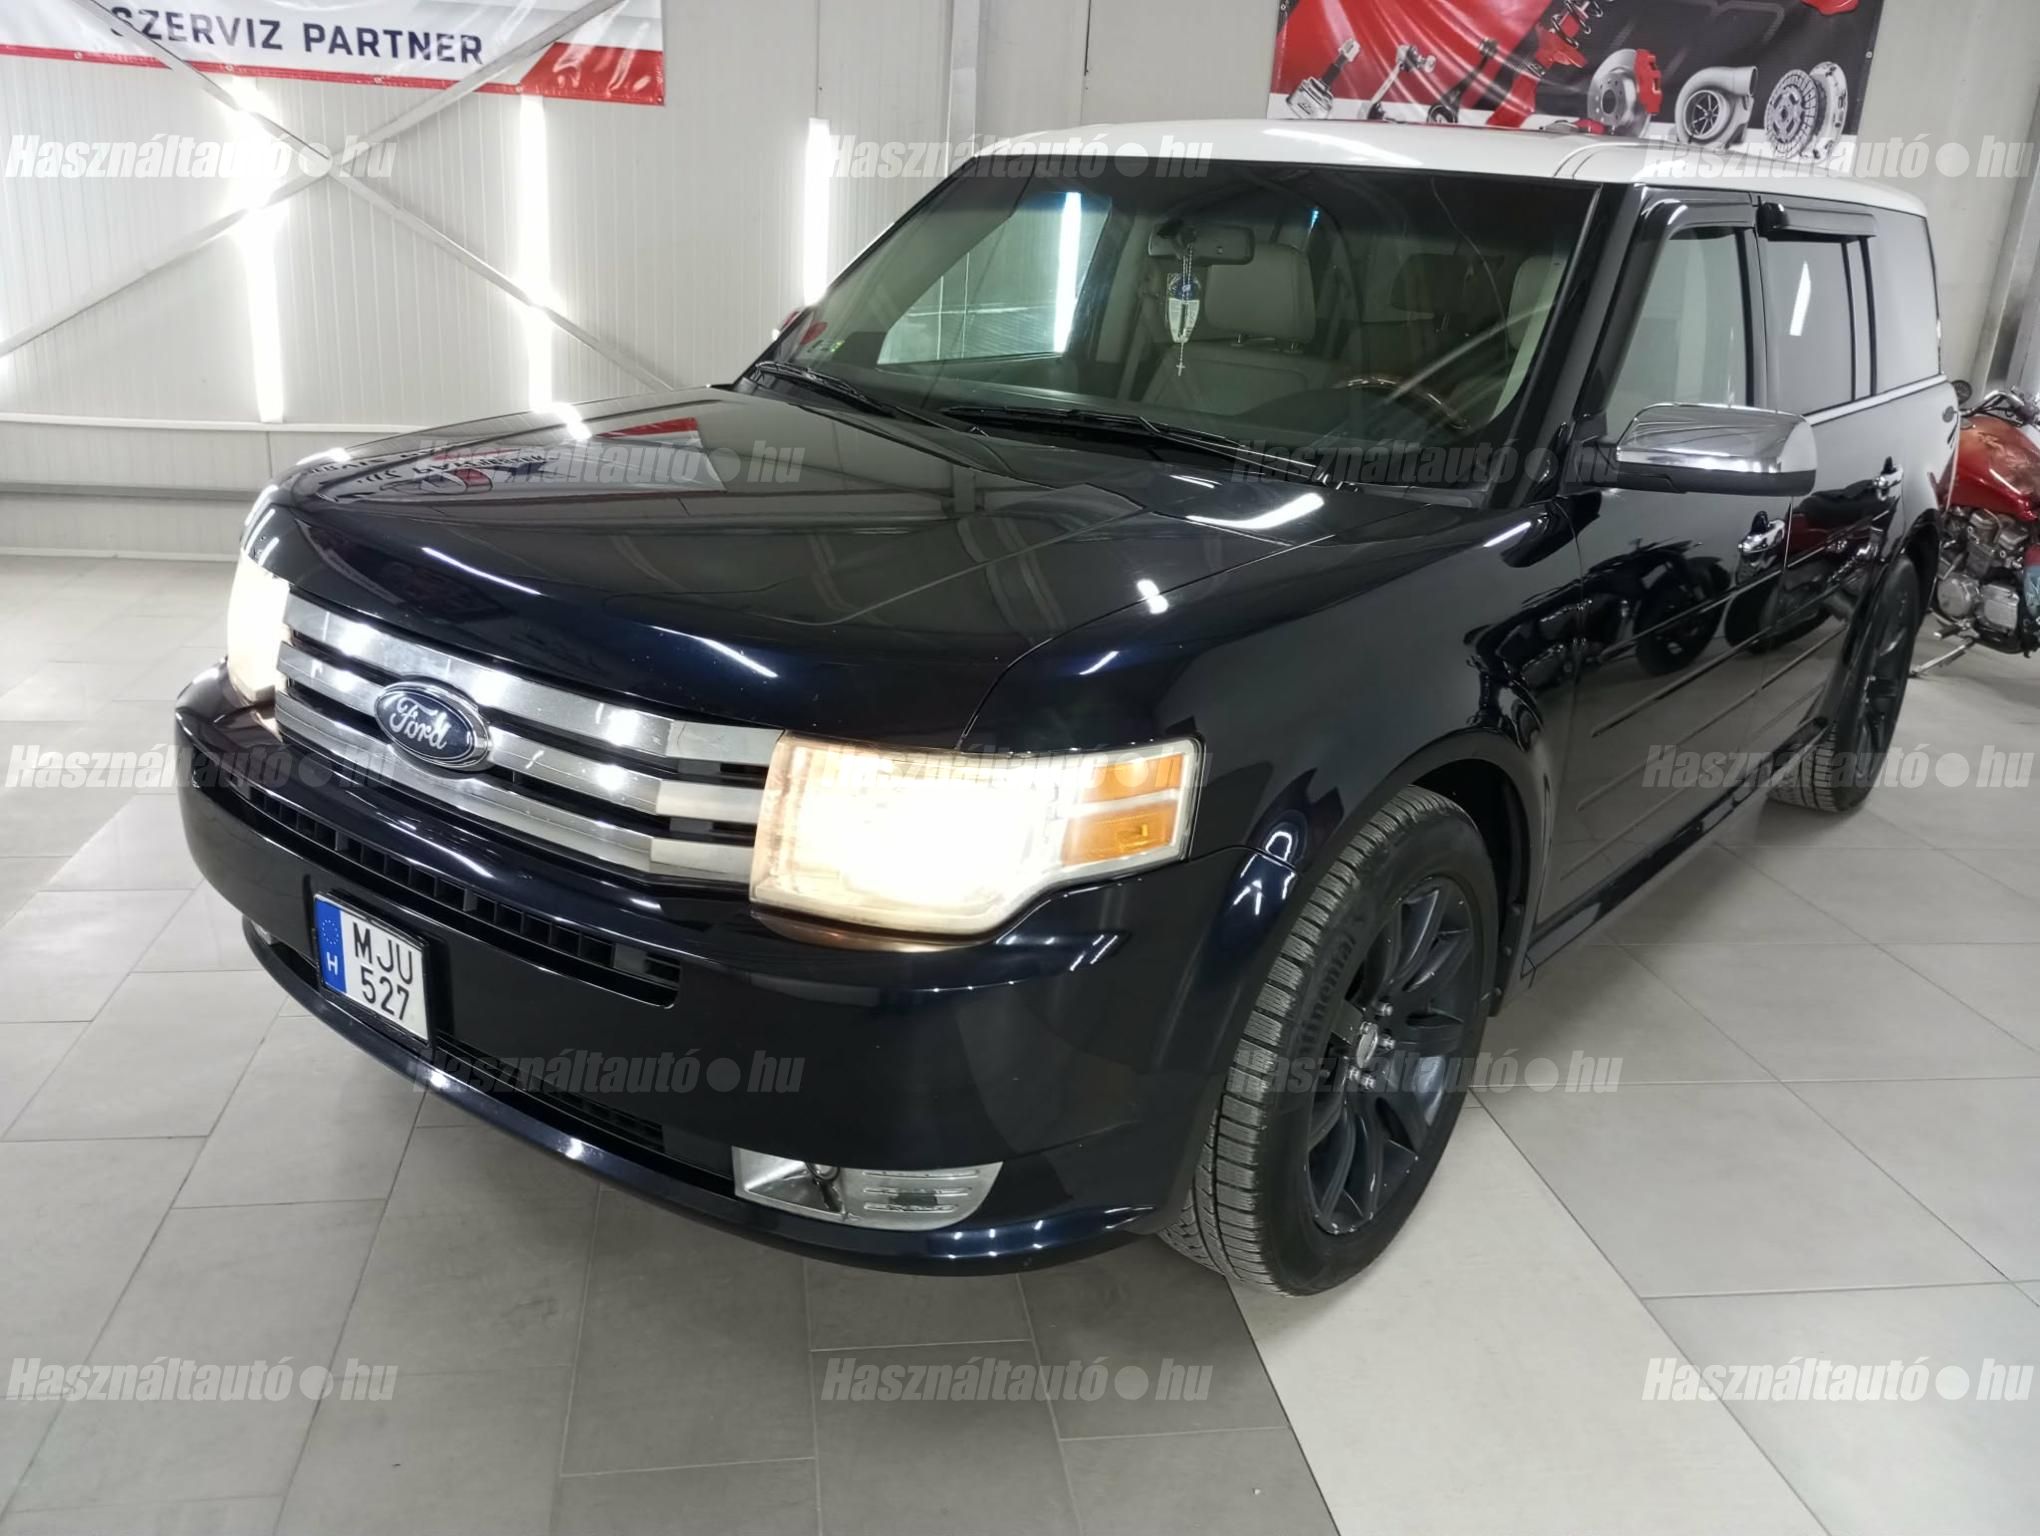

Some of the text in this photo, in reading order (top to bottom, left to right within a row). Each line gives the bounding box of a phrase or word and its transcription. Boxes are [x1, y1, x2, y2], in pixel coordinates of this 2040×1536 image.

[302, 22, 483, 64] PARTNER
[389, 696, 451, 750] Ford
[326, 951, 339, 976] H
[352, 921, 413, 985] MJU
[360, 964, 410, 1021] 527
